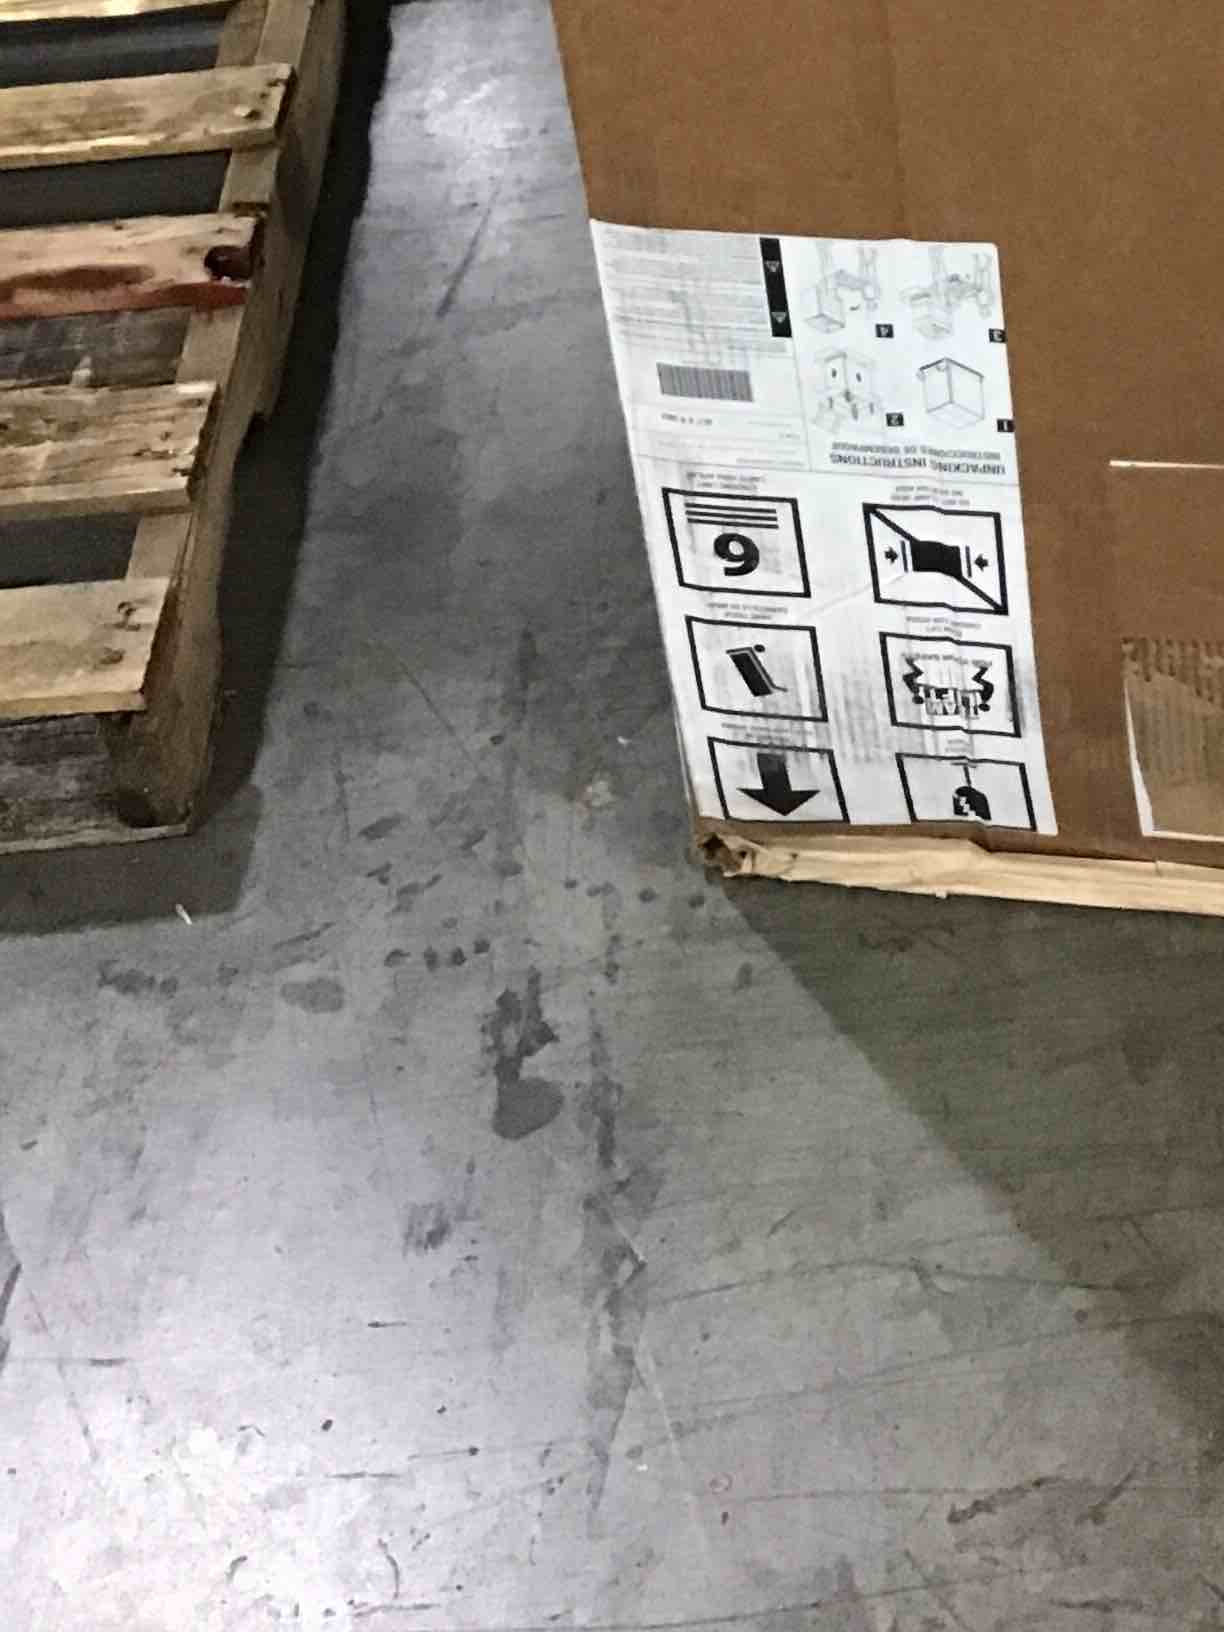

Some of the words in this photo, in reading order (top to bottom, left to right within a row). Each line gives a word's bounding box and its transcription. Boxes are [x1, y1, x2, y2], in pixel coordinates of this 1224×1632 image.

[829, 453, 927, 468] INSTRUCTIONS
[929, 459, 1006, 475] UNPACKING
[713, 532, 760, 577] 6
